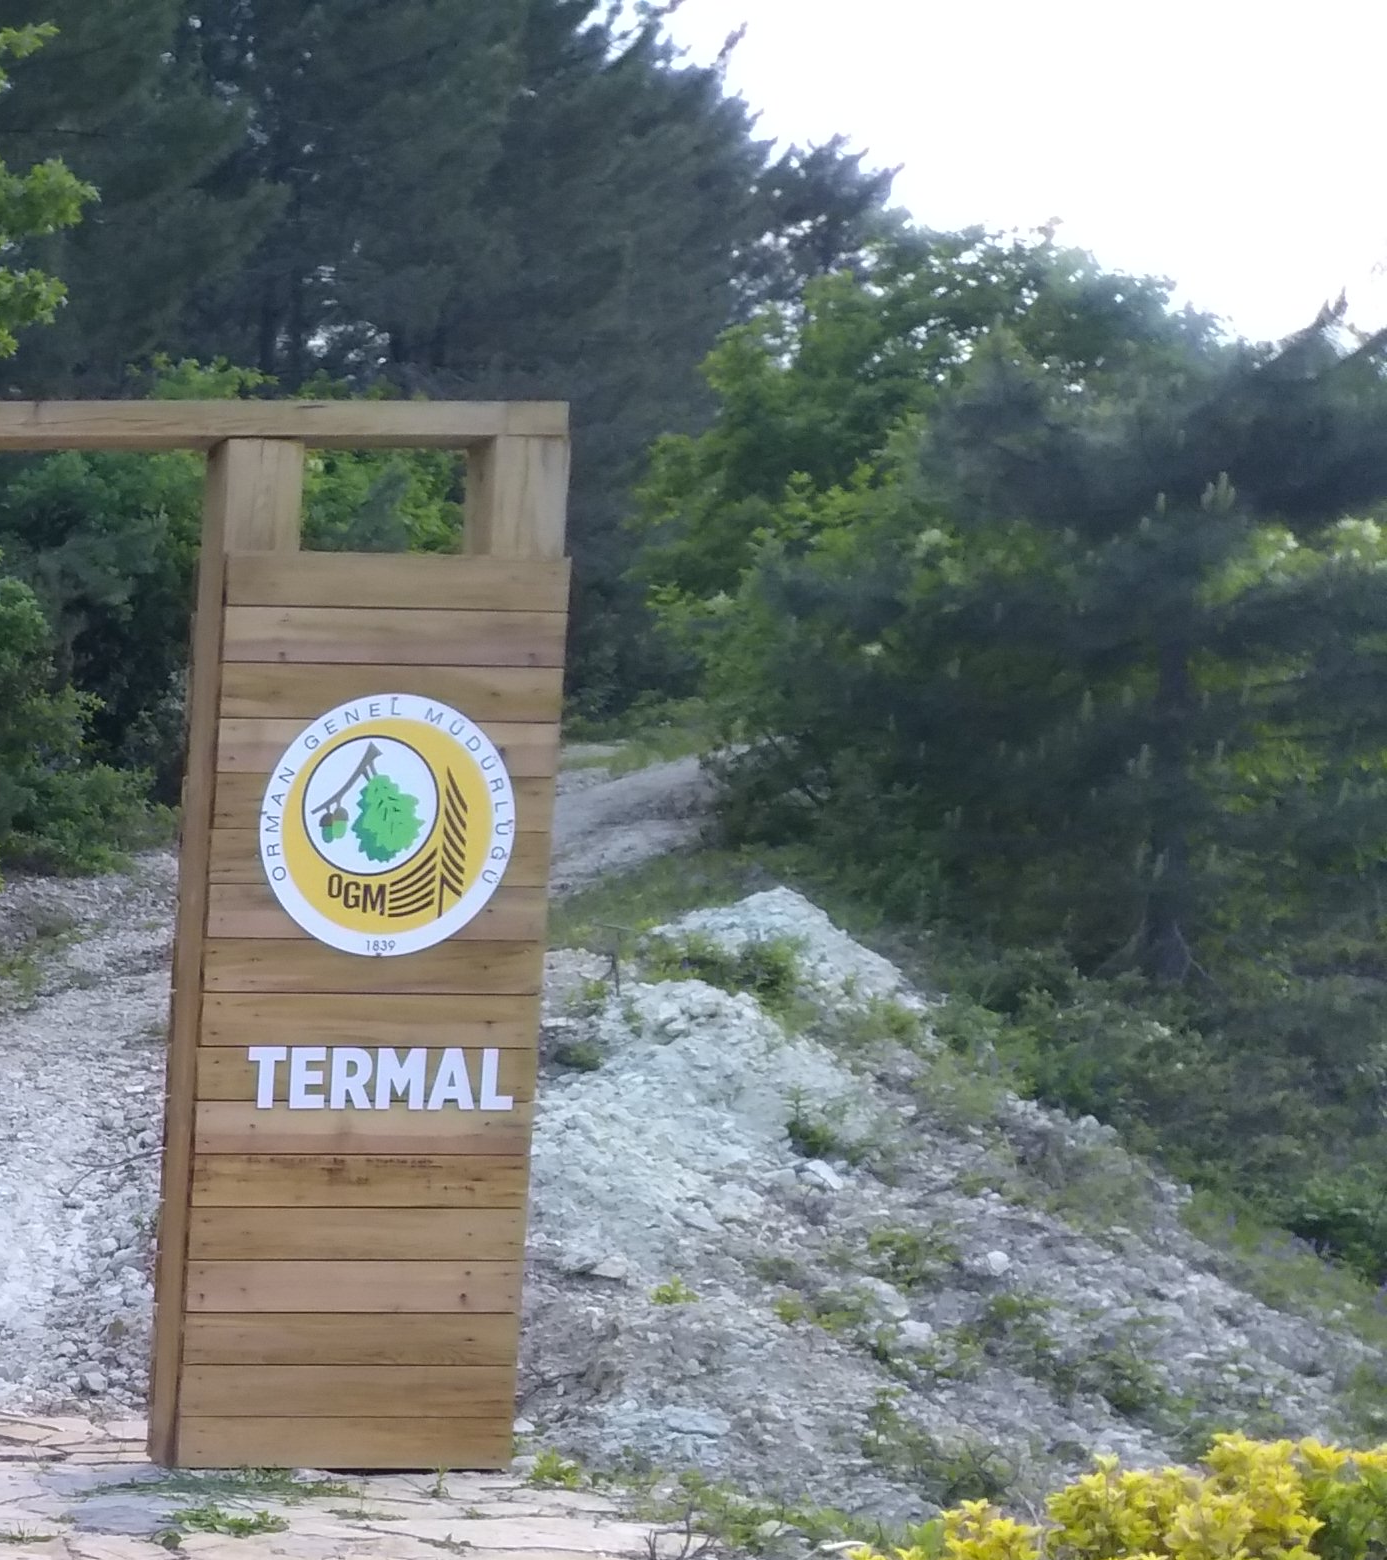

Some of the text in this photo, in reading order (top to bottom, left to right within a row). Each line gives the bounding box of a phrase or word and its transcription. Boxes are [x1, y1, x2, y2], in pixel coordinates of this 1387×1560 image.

[266, 696, 514, 885] ORMAN GENEL MÜDÜRLÜĞÜ
[327, 873, 387, 917] OGM
[365, 940, 396, 952] 1839
[248, 1046, 514, 1110] TERMAL
